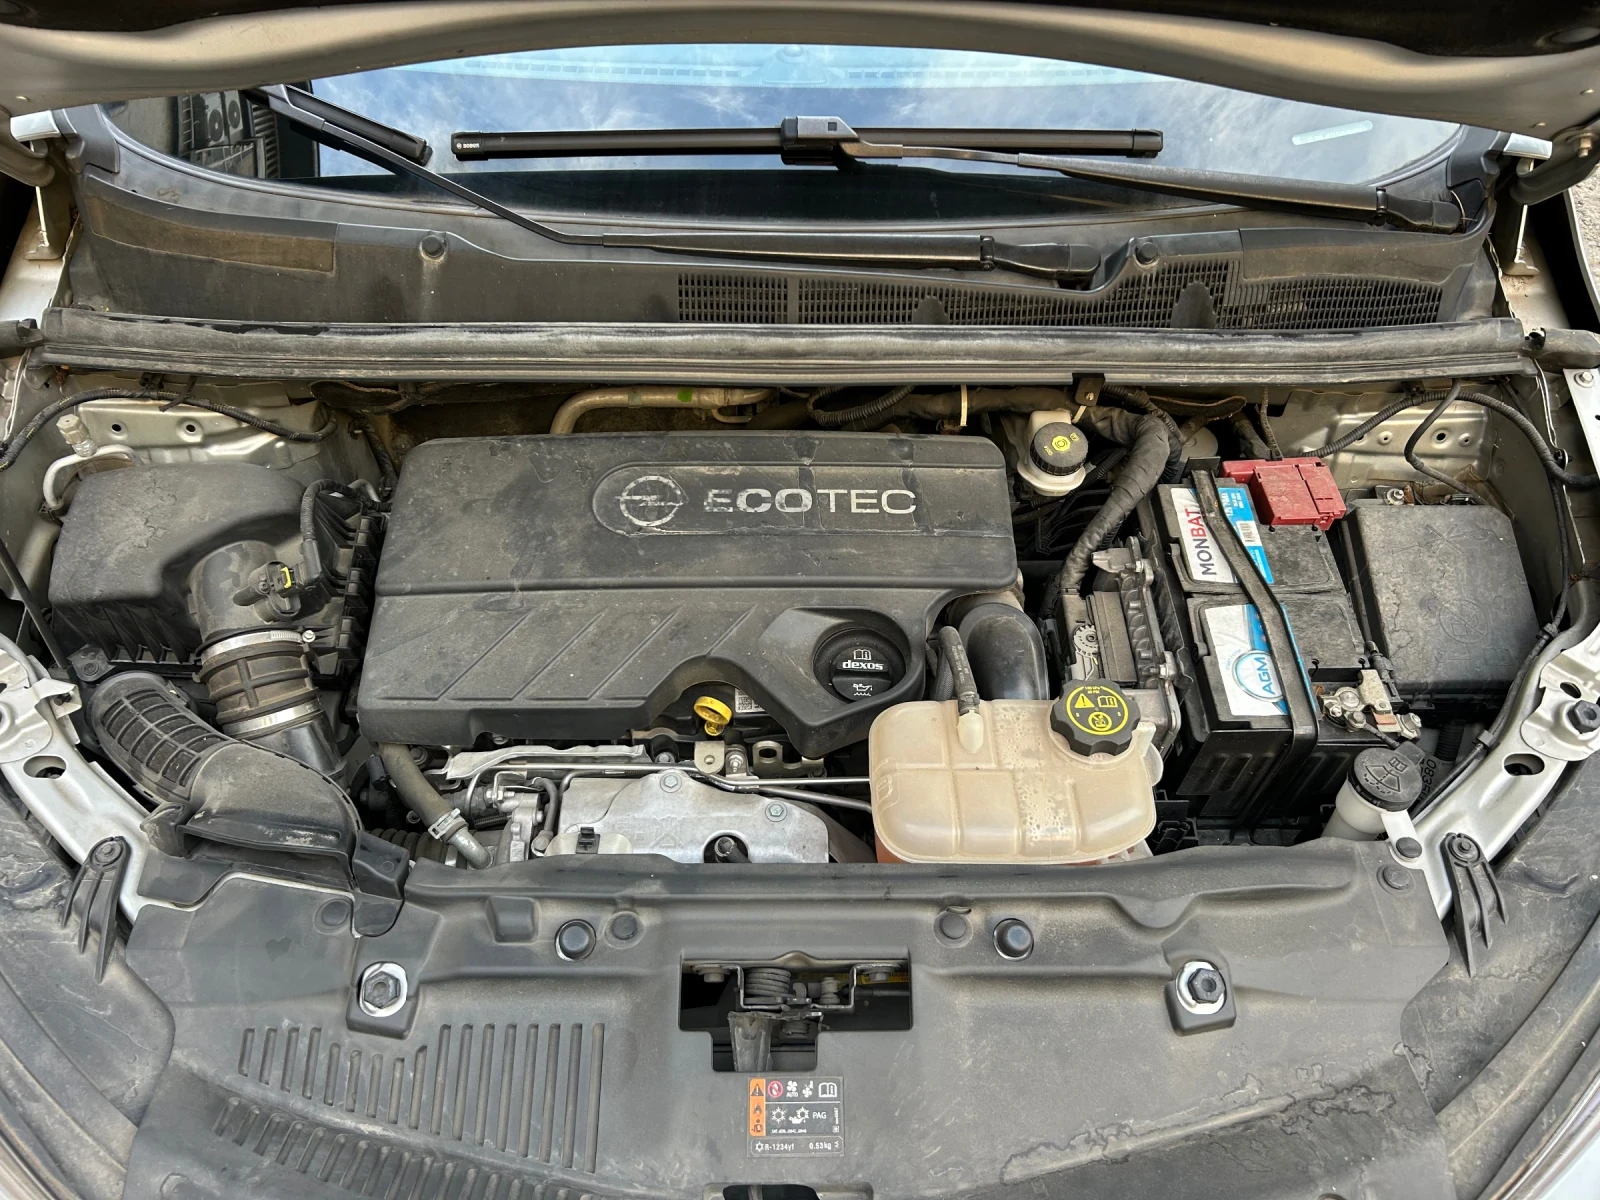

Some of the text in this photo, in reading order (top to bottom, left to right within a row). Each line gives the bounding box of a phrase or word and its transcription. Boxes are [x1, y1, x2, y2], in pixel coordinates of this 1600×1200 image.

[703, 488, 917, 514] ECOTEC
[1184, 507, 1218, 576] MONBAT
[842, 659, 885, 671] dexos
[1253, 656, 1276, 696] AGM
[812, 1111, 827, 1120] PAG
[808, 1141, 832, 1151] 0.53kg
